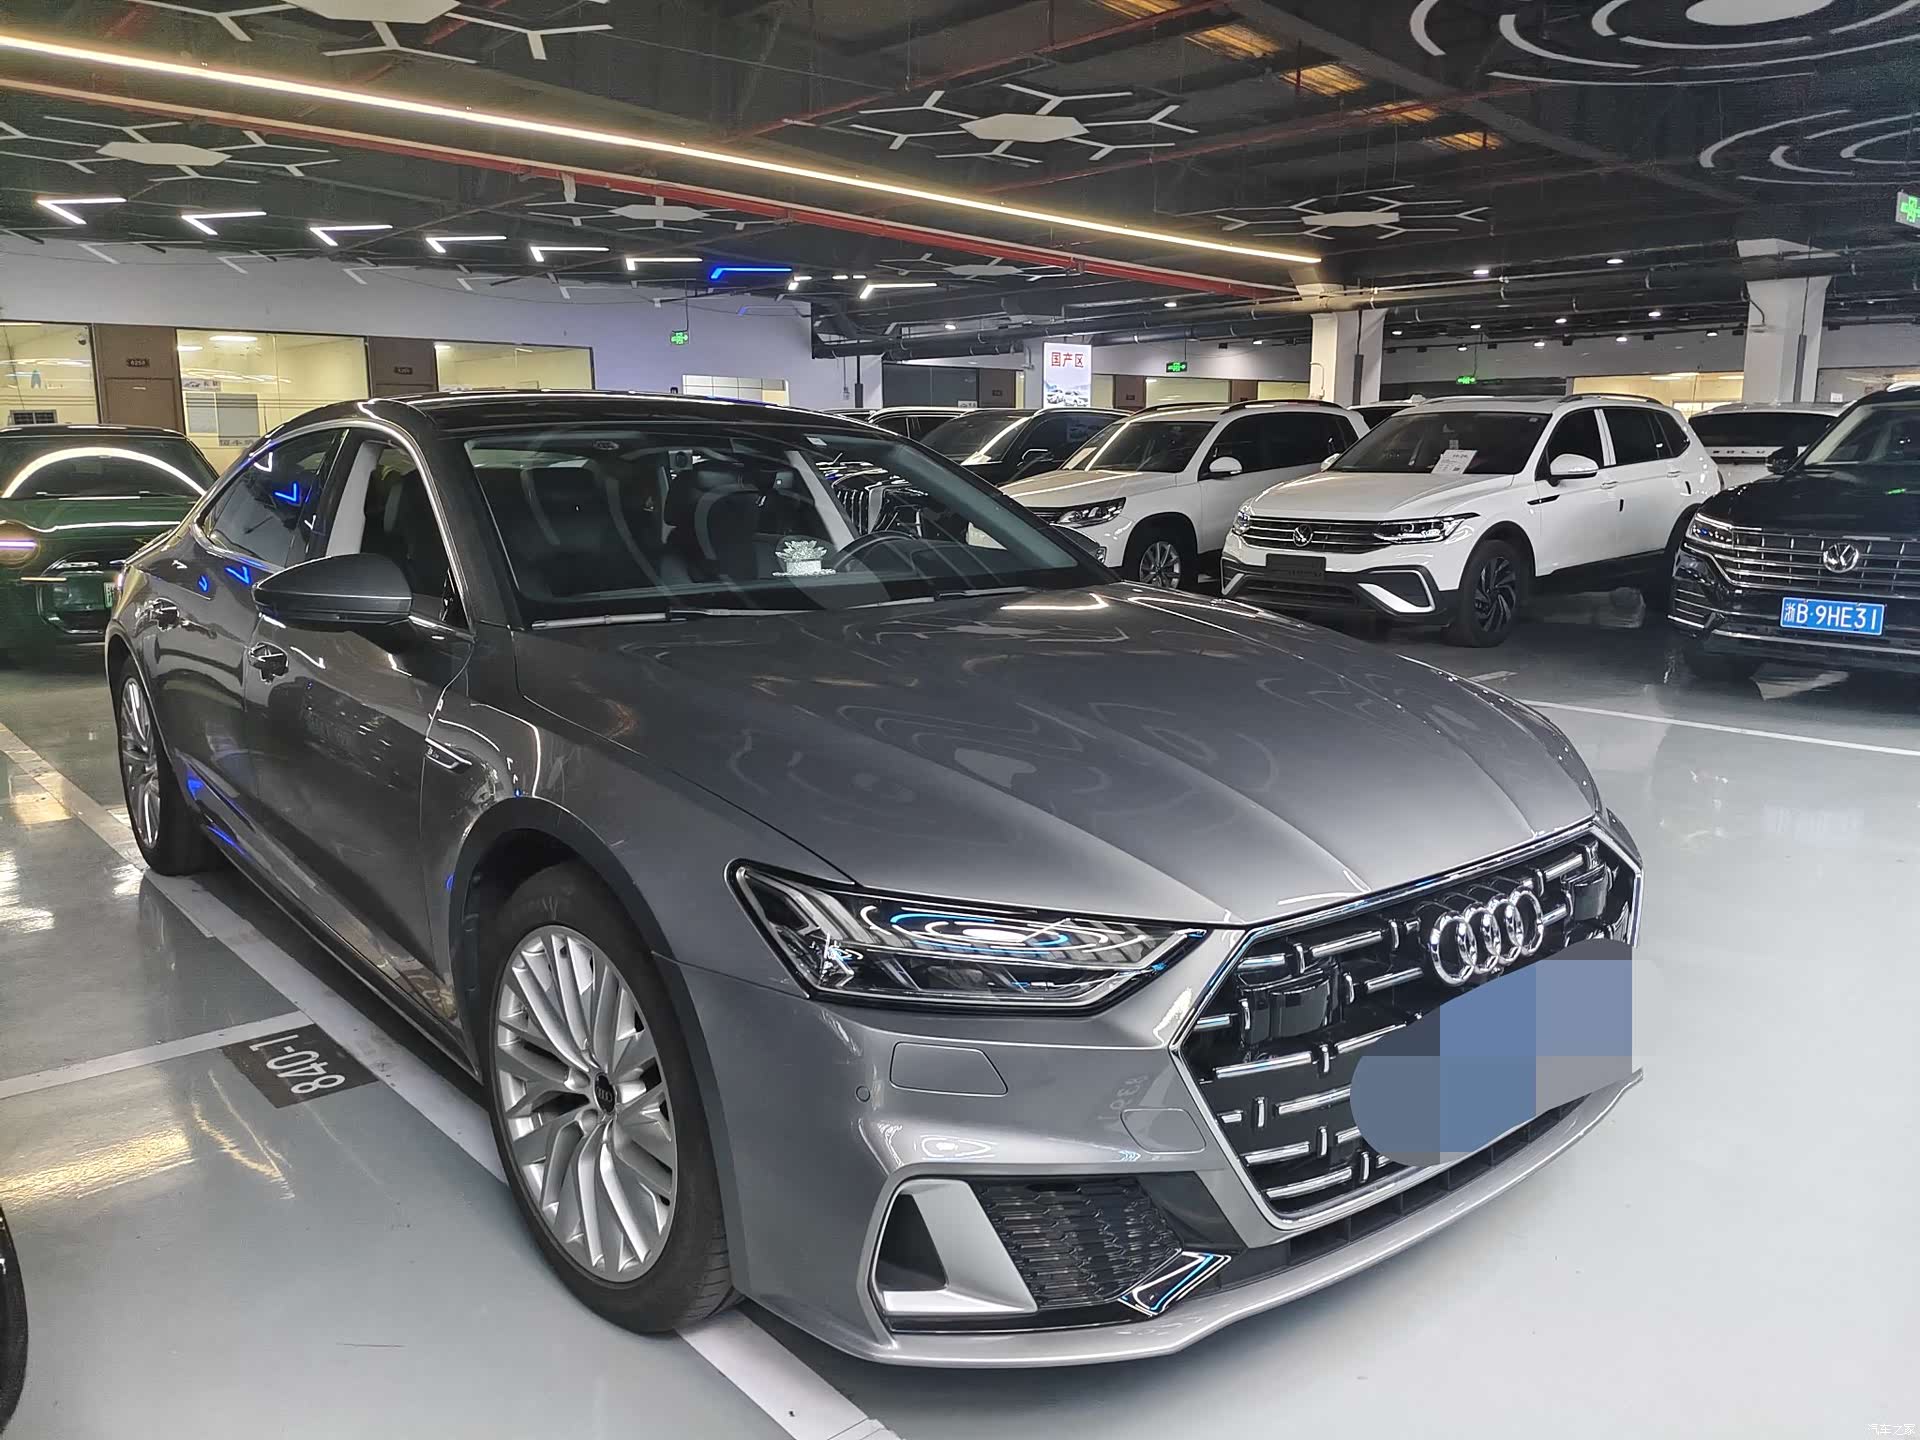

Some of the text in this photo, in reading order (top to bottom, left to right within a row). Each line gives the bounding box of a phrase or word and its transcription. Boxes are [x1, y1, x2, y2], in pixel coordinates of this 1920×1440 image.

[1051, 351, 1084, 368] 国产区
[249, 1034, 346, 1094] 840-1
